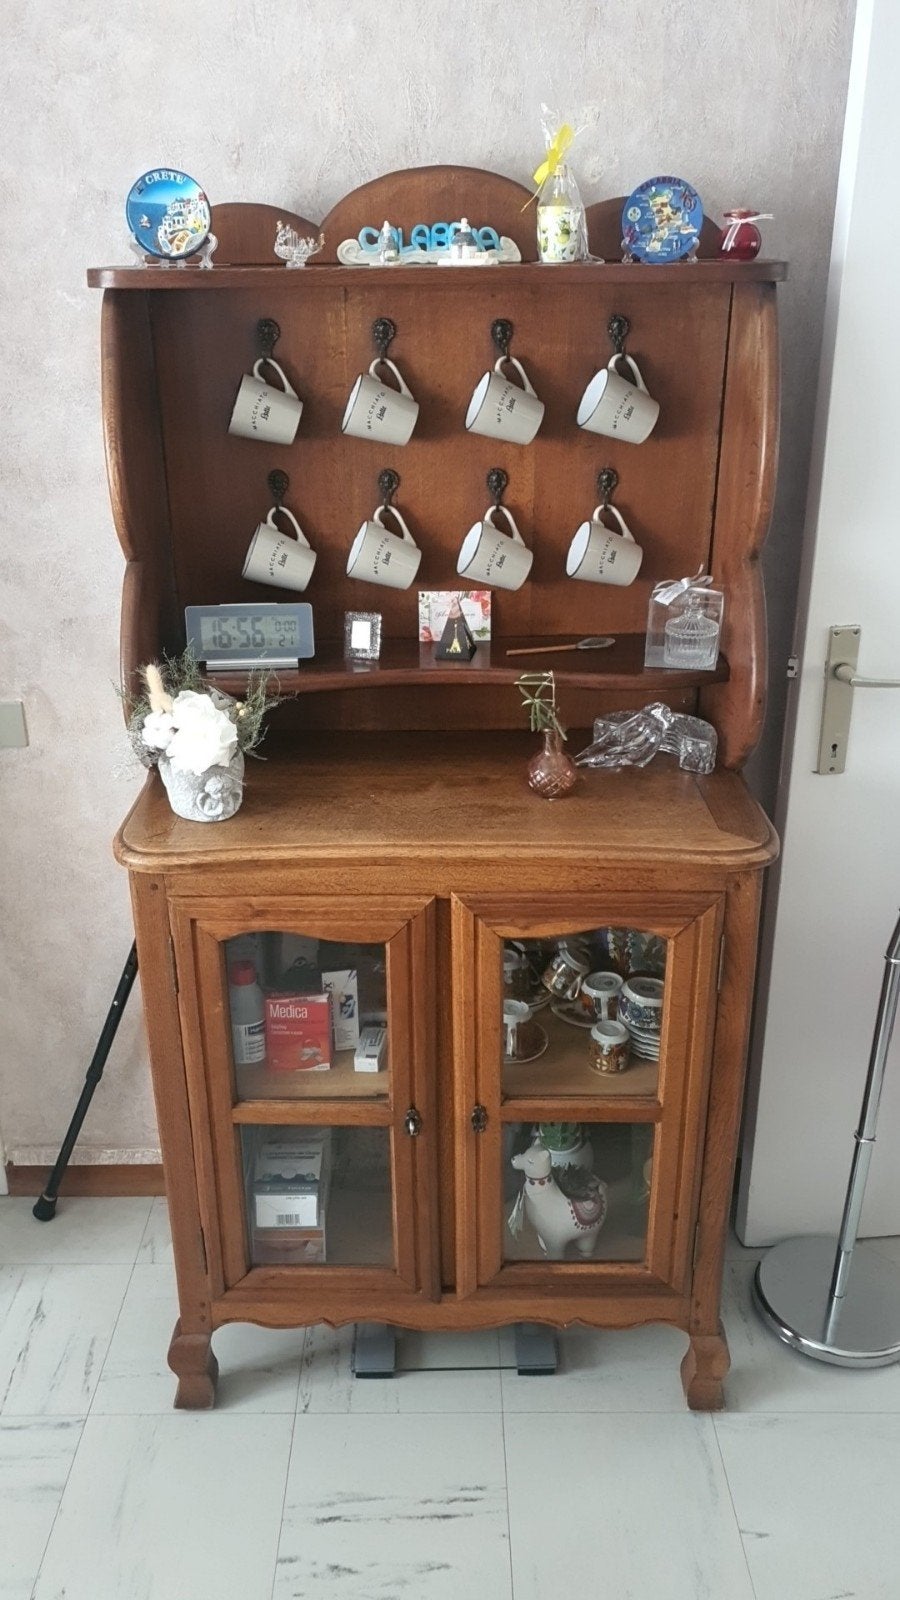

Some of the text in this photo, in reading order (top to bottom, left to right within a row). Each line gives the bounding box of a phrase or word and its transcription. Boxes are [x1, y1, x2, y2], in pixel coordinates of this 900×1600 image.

[145, 171, 186, 184] CRETE
[252, 391, 268, 430] MACCHIATO
[367, 391, 386, 430] MACCHIATO
[496, 385, 513, 423] MACCHIATO
[612, 390, 633, 430] MACCHIATO
[270, 539, 286, 577] MACCHIATO
[373, 537, 390, 575] MACCHIATO
[486, 540, 505, 577] MACCHIATO
[598, 536, 614, 575] MACCHIATO
[269, 1003, 308, 1019] Medica
